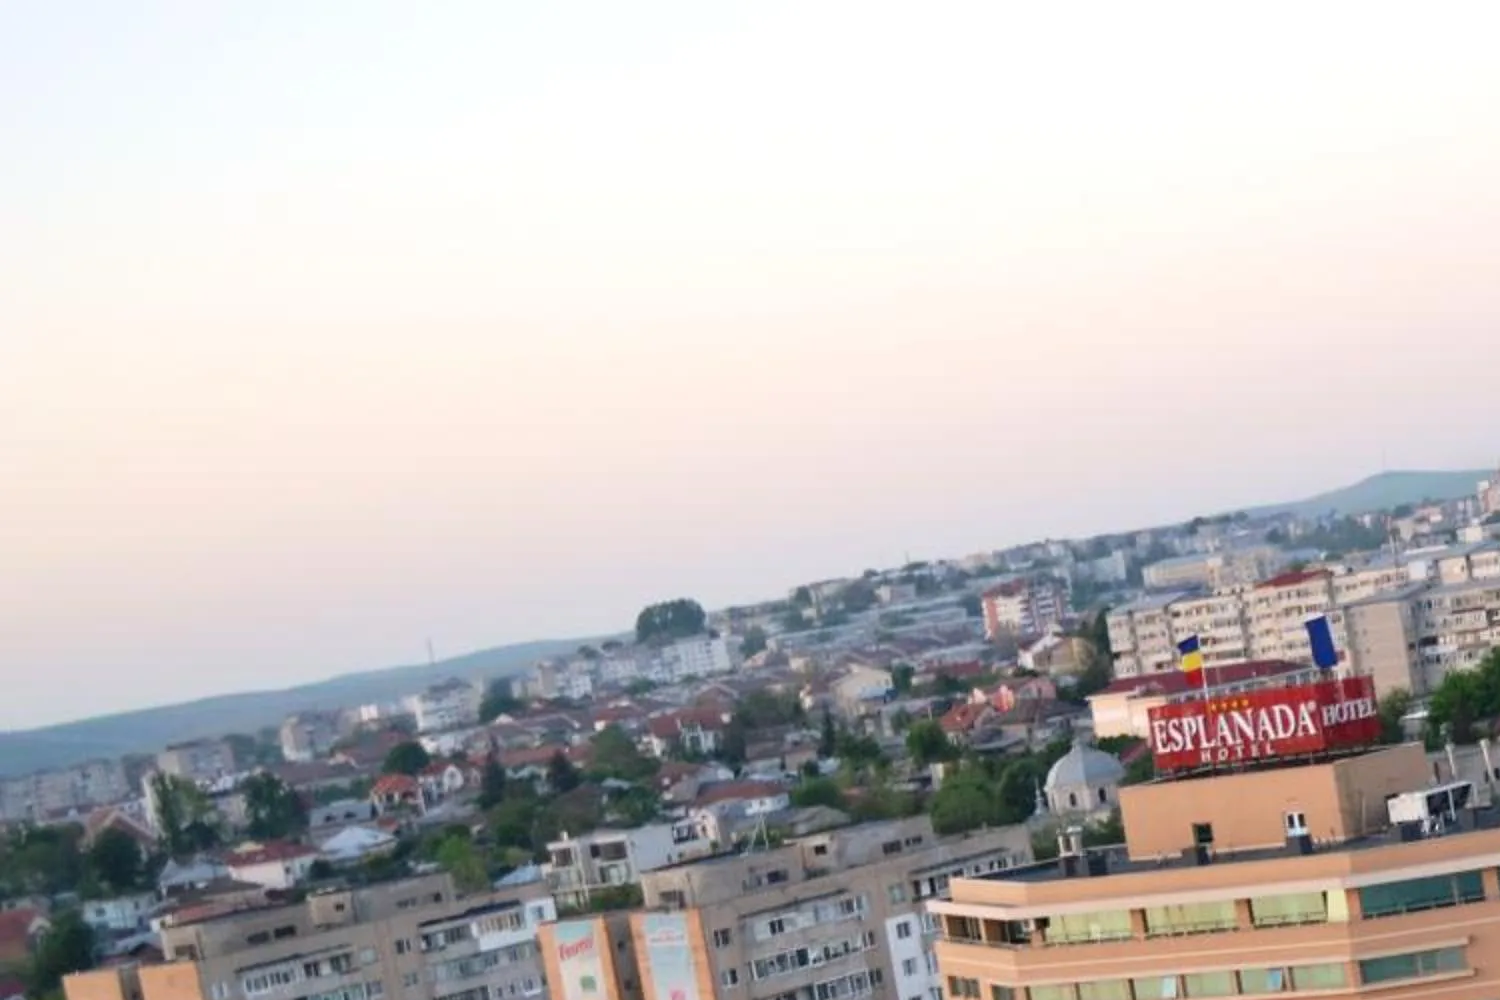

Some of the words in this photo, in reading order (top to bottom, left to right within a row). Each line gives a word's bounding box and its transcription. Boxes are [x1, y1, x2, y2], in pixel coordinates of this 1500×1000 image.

[1151, 702, 1317, 754] ESPLANADA
[1321, 697, 1377, 728] HOTEL
[1200, 742, 1276, 762] HOTEL
